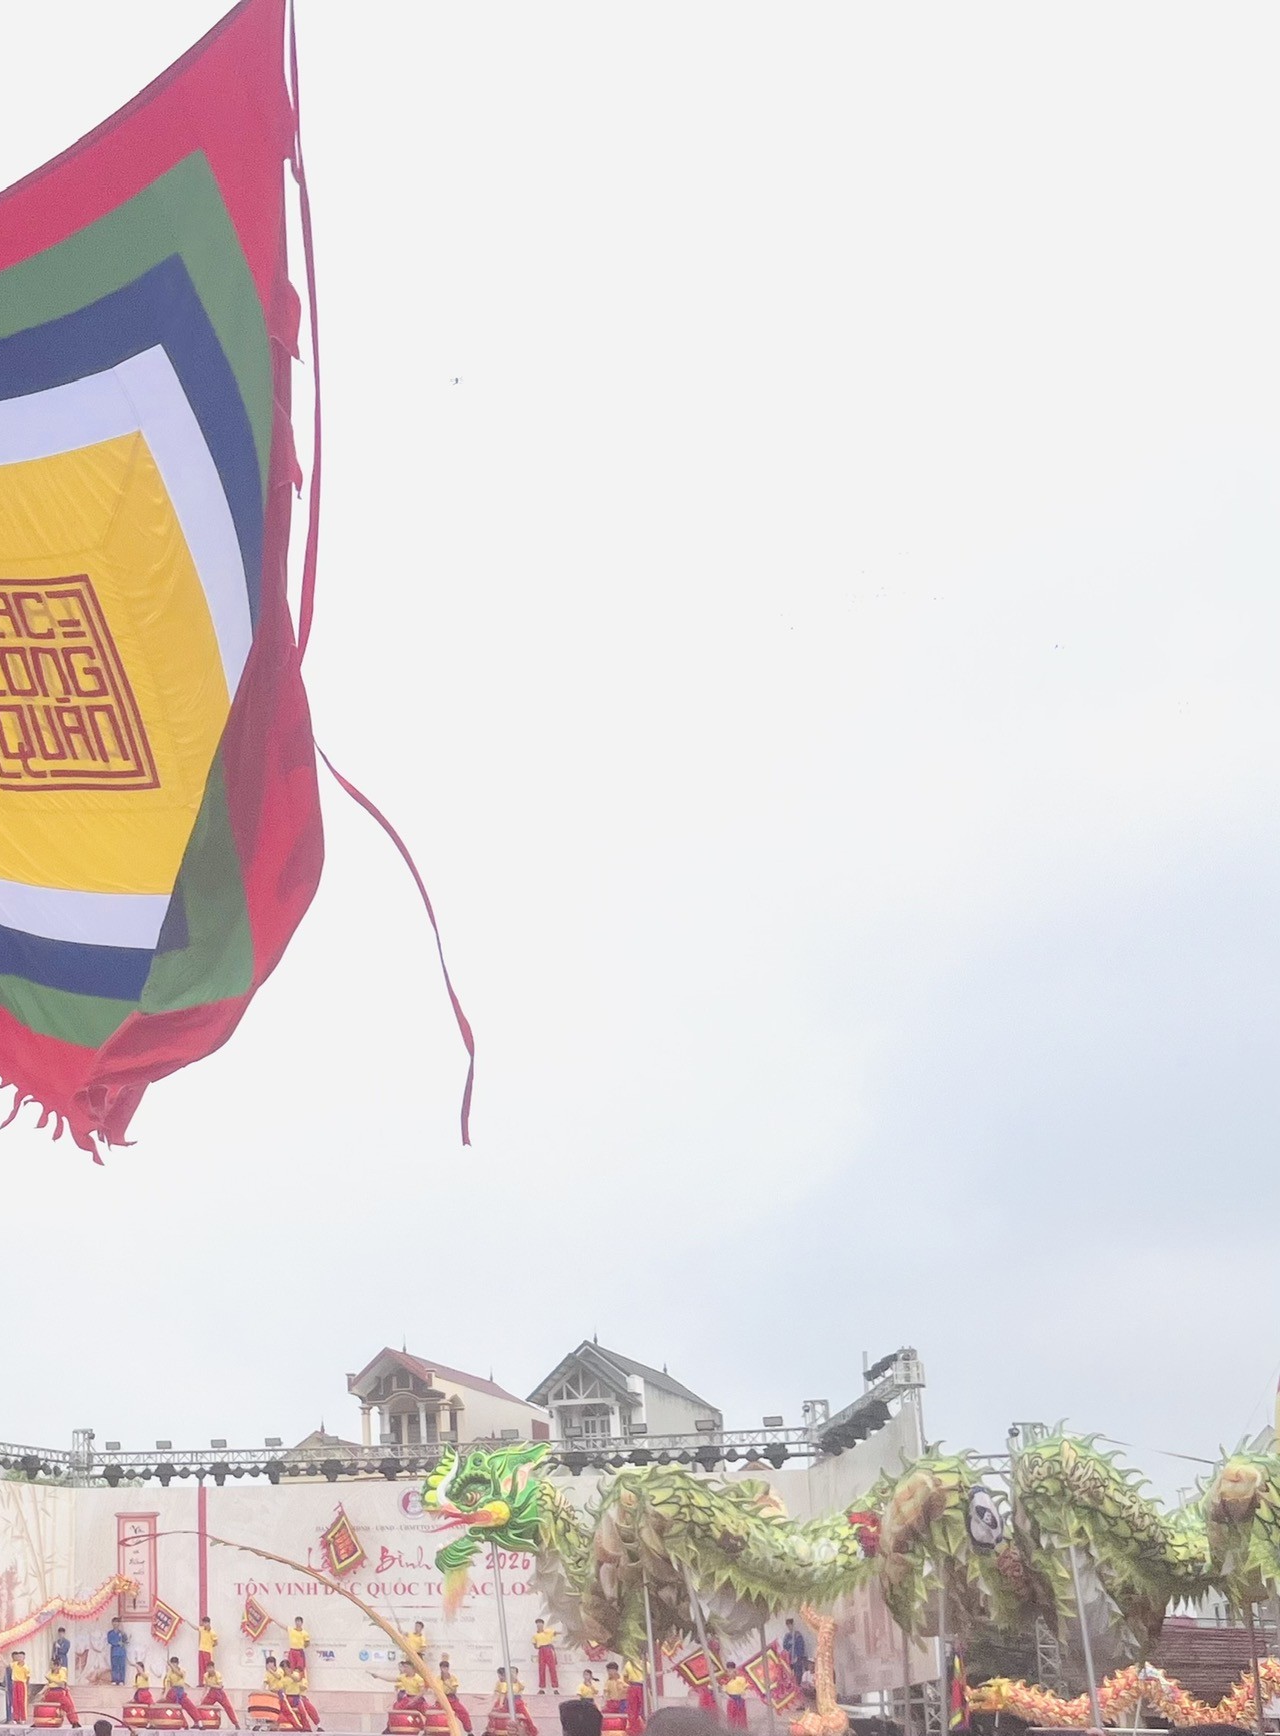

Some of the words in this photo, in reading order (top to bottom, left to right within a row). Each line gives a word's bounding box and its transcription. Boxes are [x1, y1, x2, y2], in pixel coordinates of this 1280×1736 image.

[376, 1546, 431, 1574] Bình
[486, 1552, 530, 1570] 2026
[234, 1578, 269, 1596] TÔN
[275, 1582, 318, 1596] VINH
[367, 1578, 419, 1598] QUỐC
